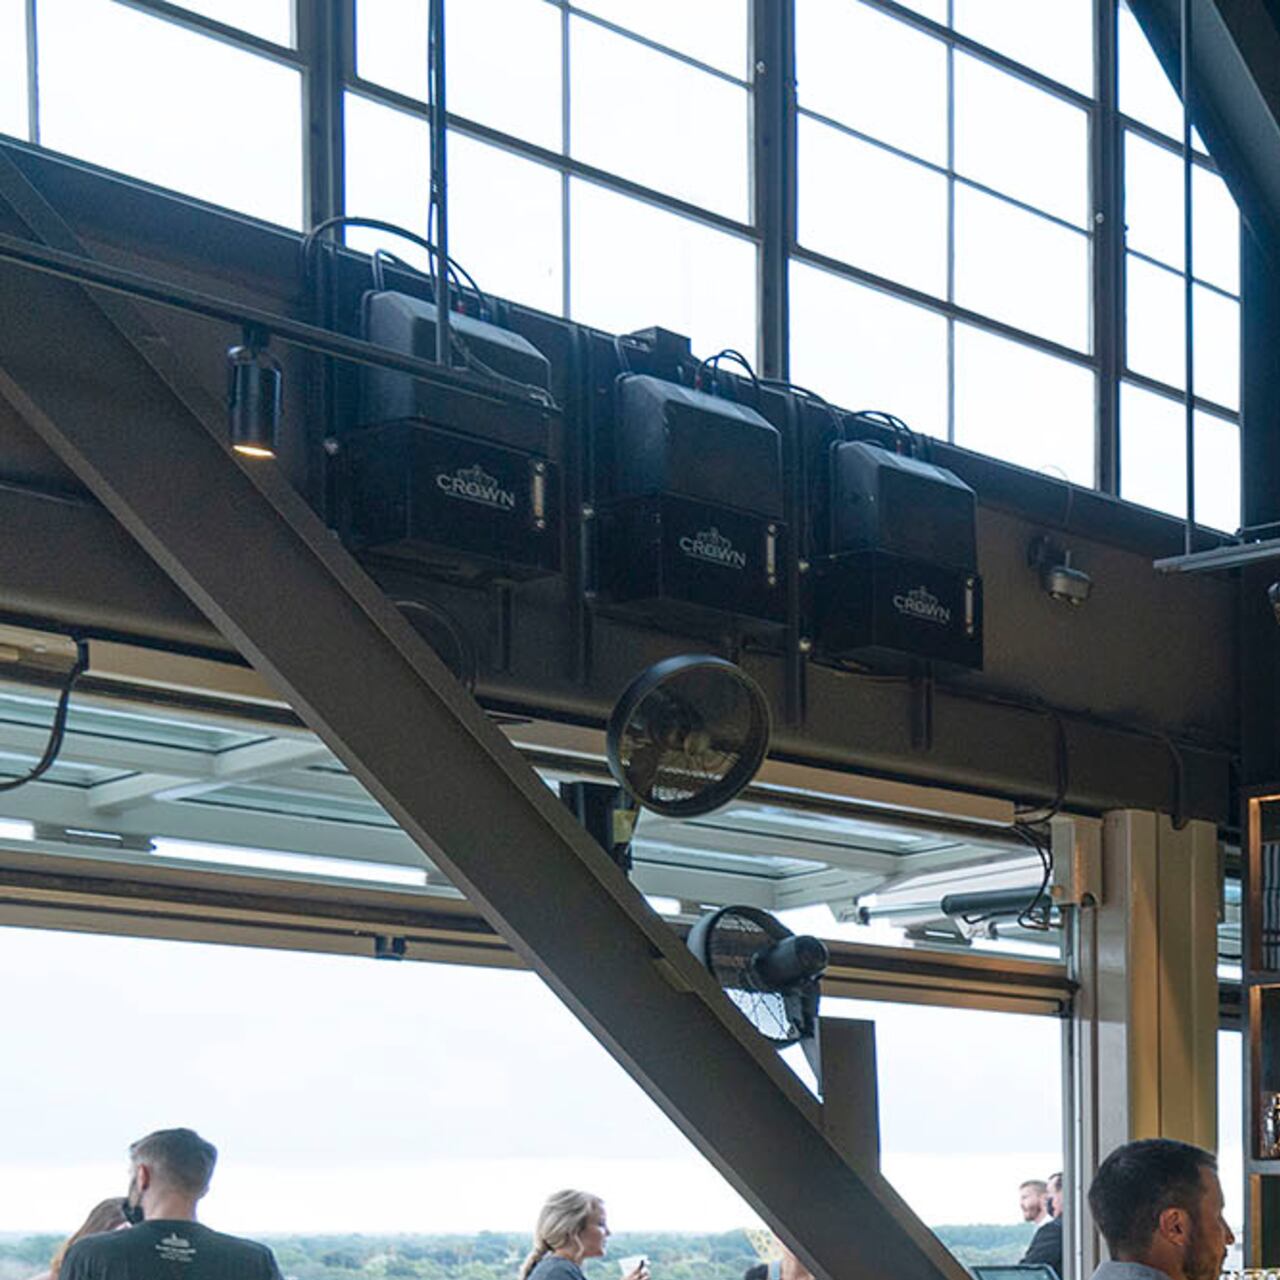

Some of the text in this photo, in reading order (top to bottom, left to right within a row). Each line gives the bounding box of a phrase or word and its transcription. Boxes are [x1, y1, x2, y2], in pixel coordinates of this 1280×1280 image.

[436, 474, 515, 507] CROWN
[679, 536, 747, 568] CROWN
[892, 594, 952, 621] CROWN
